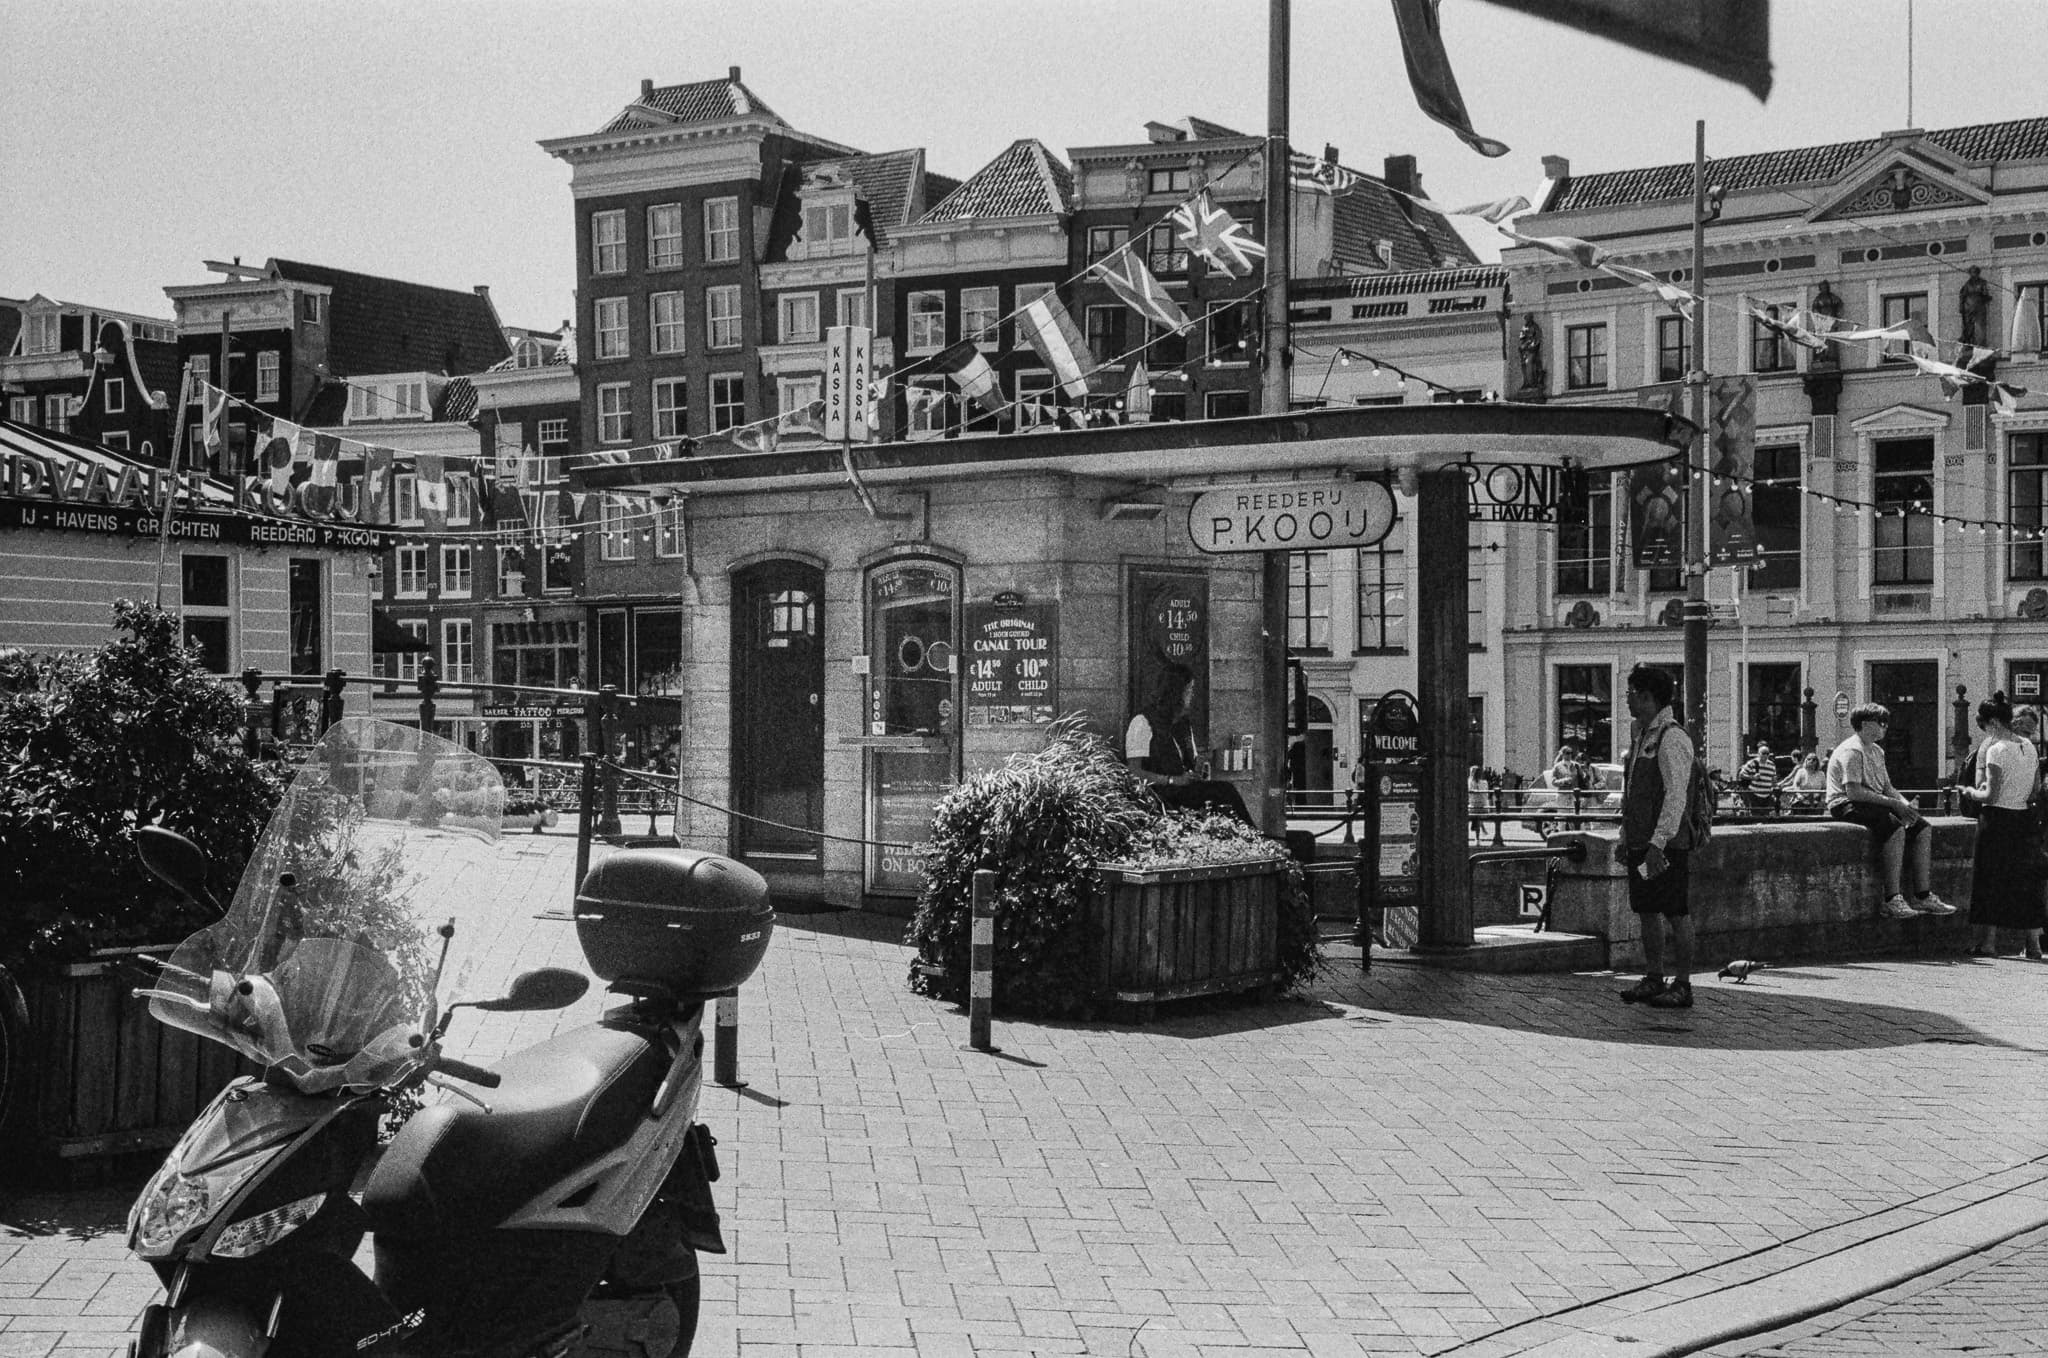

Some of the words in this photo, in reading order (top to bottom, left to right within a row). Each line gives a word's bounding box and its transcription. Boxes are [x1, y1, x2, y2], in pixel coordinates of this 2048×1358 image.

[831, 346, 841, 422] KASSA
[855, 346, 864, 423] KASSA
[0, 453, 209, 512] DVAART
[1238, 489, 1342, 511] REEDERIJ
[22, 507, 36, 525] IJ
[56, 511, 118, 531] HAVENS
[137, 518, 220, 538] GRCHTEN
[251, 525, 316, 543] REEDERIJ
[973, 639, 1011, 652] CANAL
[1014, 638, 1048, 651] TOUR
[971, 681, 1003, 691] ADULT
[1018, 680, 1048, 690] CHILD
[513, 706, 552, 717] TATTOO
[1375, 735, 1419, 751] WELCOME
[882, 858, 902, 872] ON
